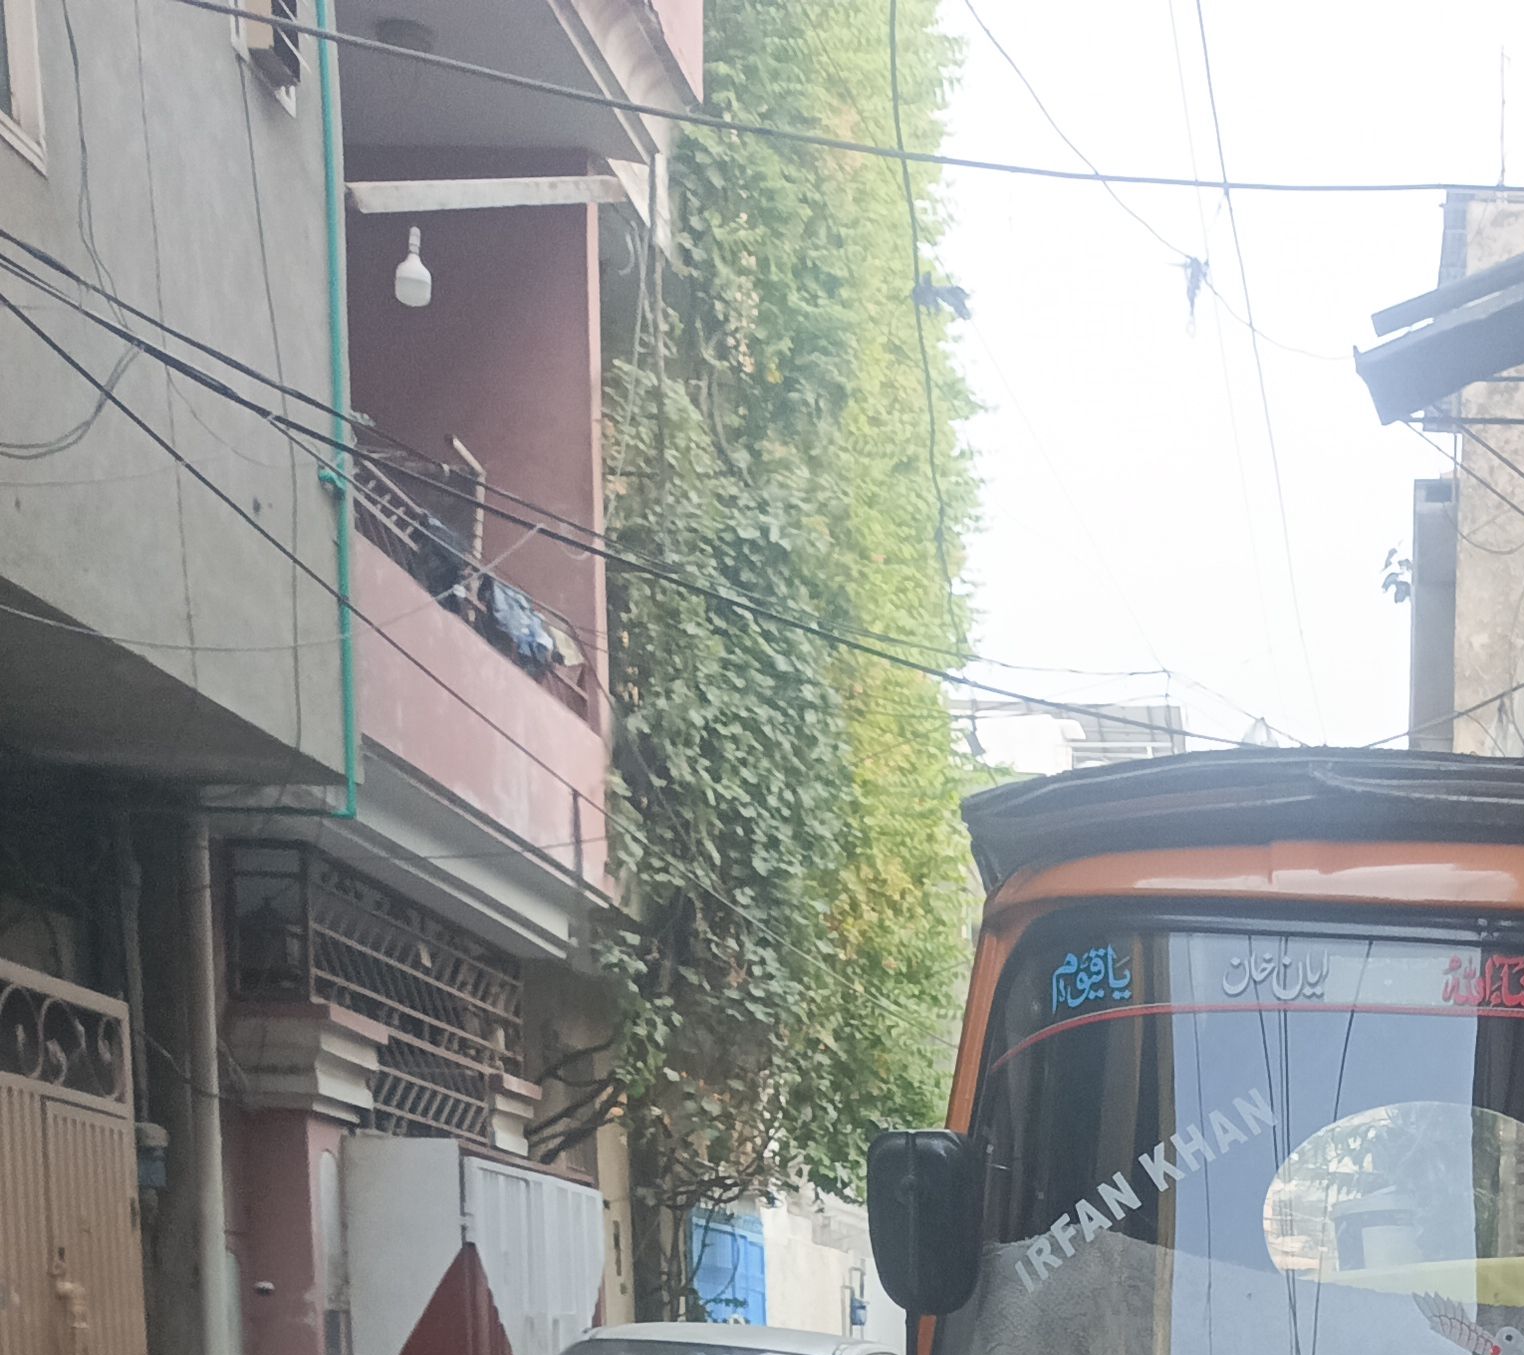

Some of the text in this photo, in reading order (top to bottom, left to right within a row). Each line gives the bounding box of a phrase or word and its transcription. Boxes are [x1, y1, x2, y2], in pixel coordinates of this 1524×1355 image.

[1222, 951, 1276, 997] خان
[1014, 1088, 1279, 1296] IRFAN KHAN
